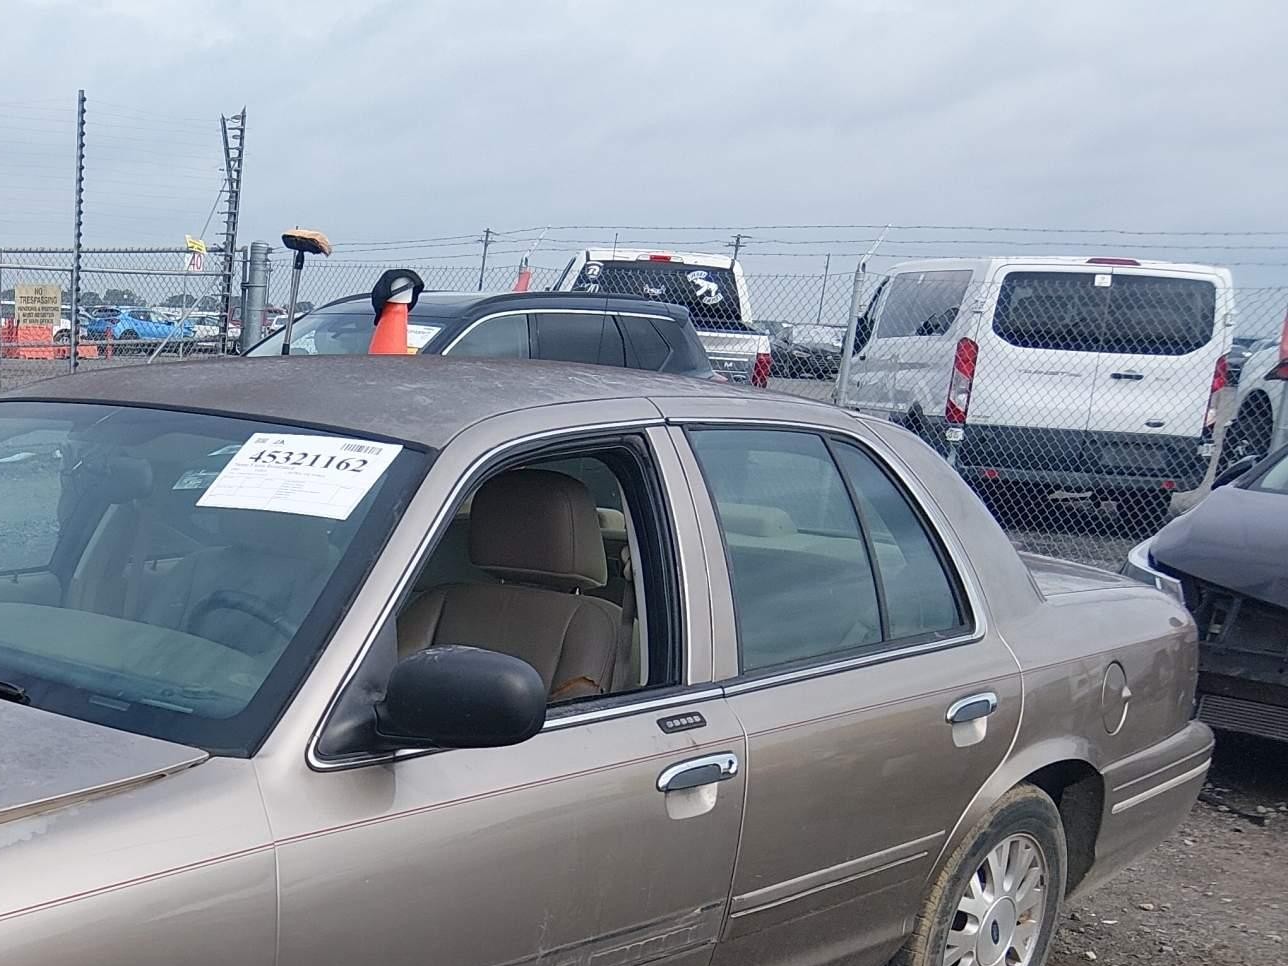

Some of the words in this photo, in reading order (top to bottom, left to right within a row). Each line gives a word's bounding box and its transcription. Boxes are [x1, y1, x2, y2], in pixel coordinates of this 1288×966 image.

[34, 287, 43, 296] NO
[19, 296, 58, 304] TRESPASSING
[249, 449, 368, 473] 45321162
